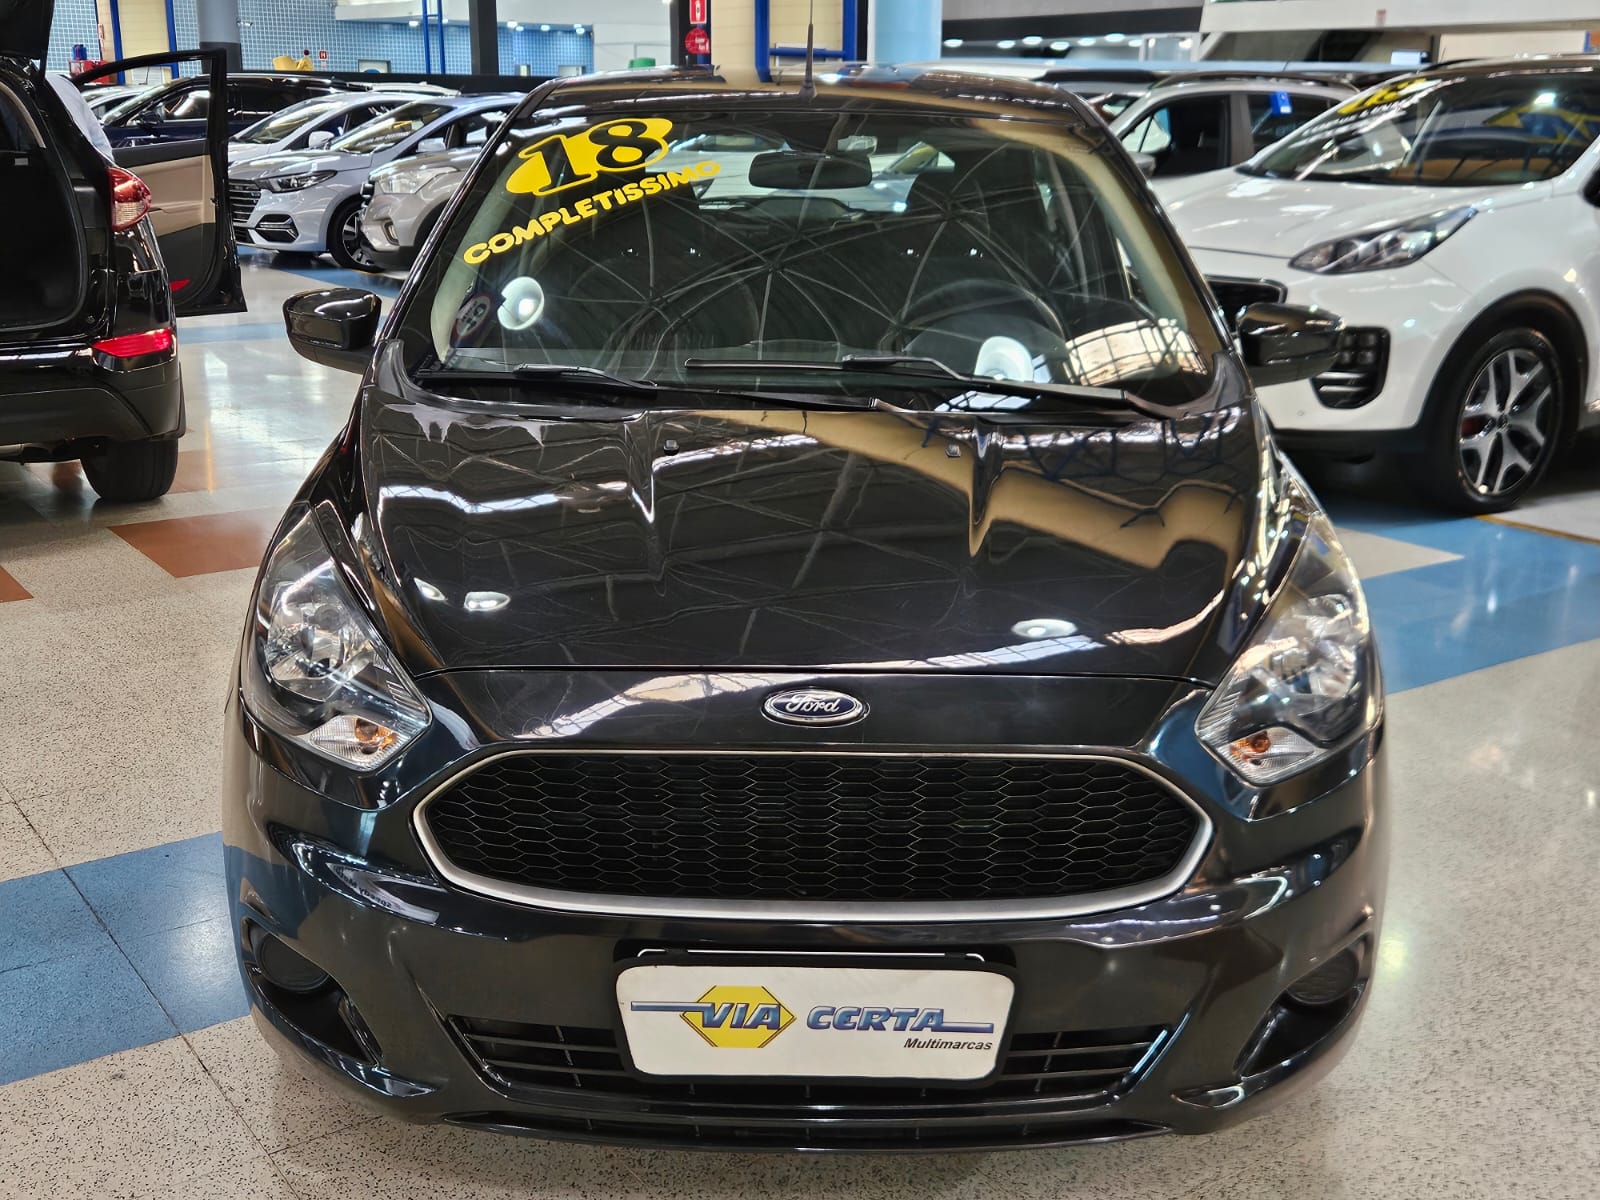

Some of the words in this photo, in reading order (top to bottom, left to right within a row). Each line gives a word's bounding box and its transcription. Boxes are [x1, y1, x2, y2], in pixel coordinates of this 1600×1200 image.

[508, 118, 672, 196] 18
[463, 160, 720, 265] COMPLETISSIMO
[785, 693, 841, 712] Ford
[700, 1002, 781, 1030] VIA
[806, 1006, 945, 1032] CERTA
[903, 1037, 993, 1051] Multimarcas
